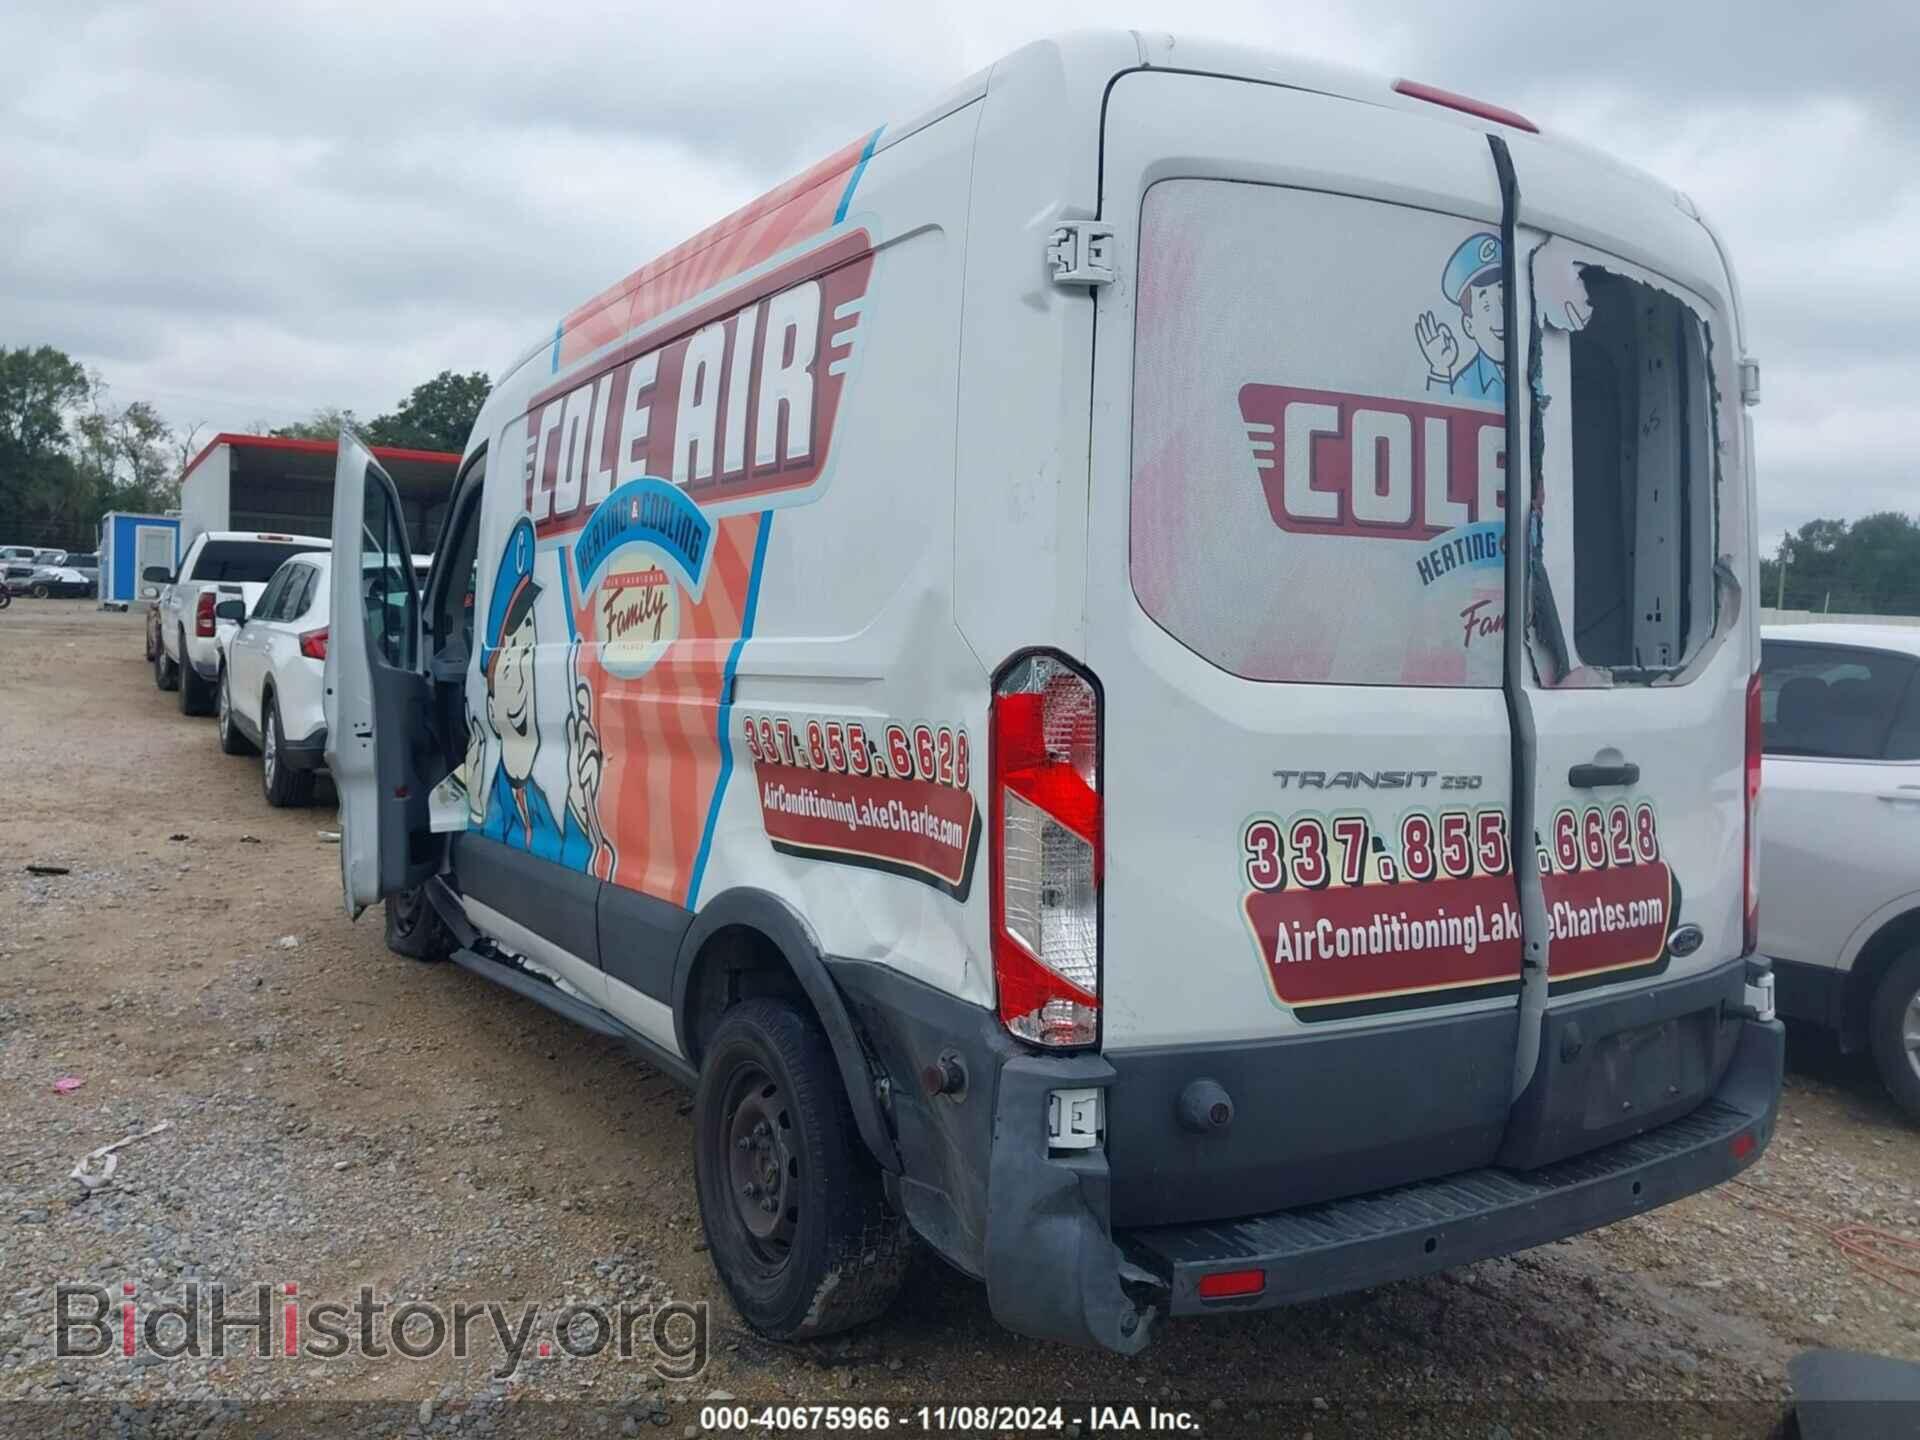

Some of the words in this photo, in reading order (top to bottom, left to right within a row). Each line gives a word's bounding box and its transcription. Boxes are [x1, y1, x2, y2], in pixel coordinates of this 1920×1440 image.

[532, 350, 661, 521] COLE
[672, 280, 821, 484] AIR
[1283, 401, 1506, 527] COLE
[640, 491, 702, 564] COOLING
[1416, 532, 1497, 586] HEATING
[602, 564, 668, 643] Family
[763, 783, 963, 850] AirConditioningLakeCharles.com
[1272, 771, 1437, 789] TRANSIT
[1440, 776, 1482, 790] 250
